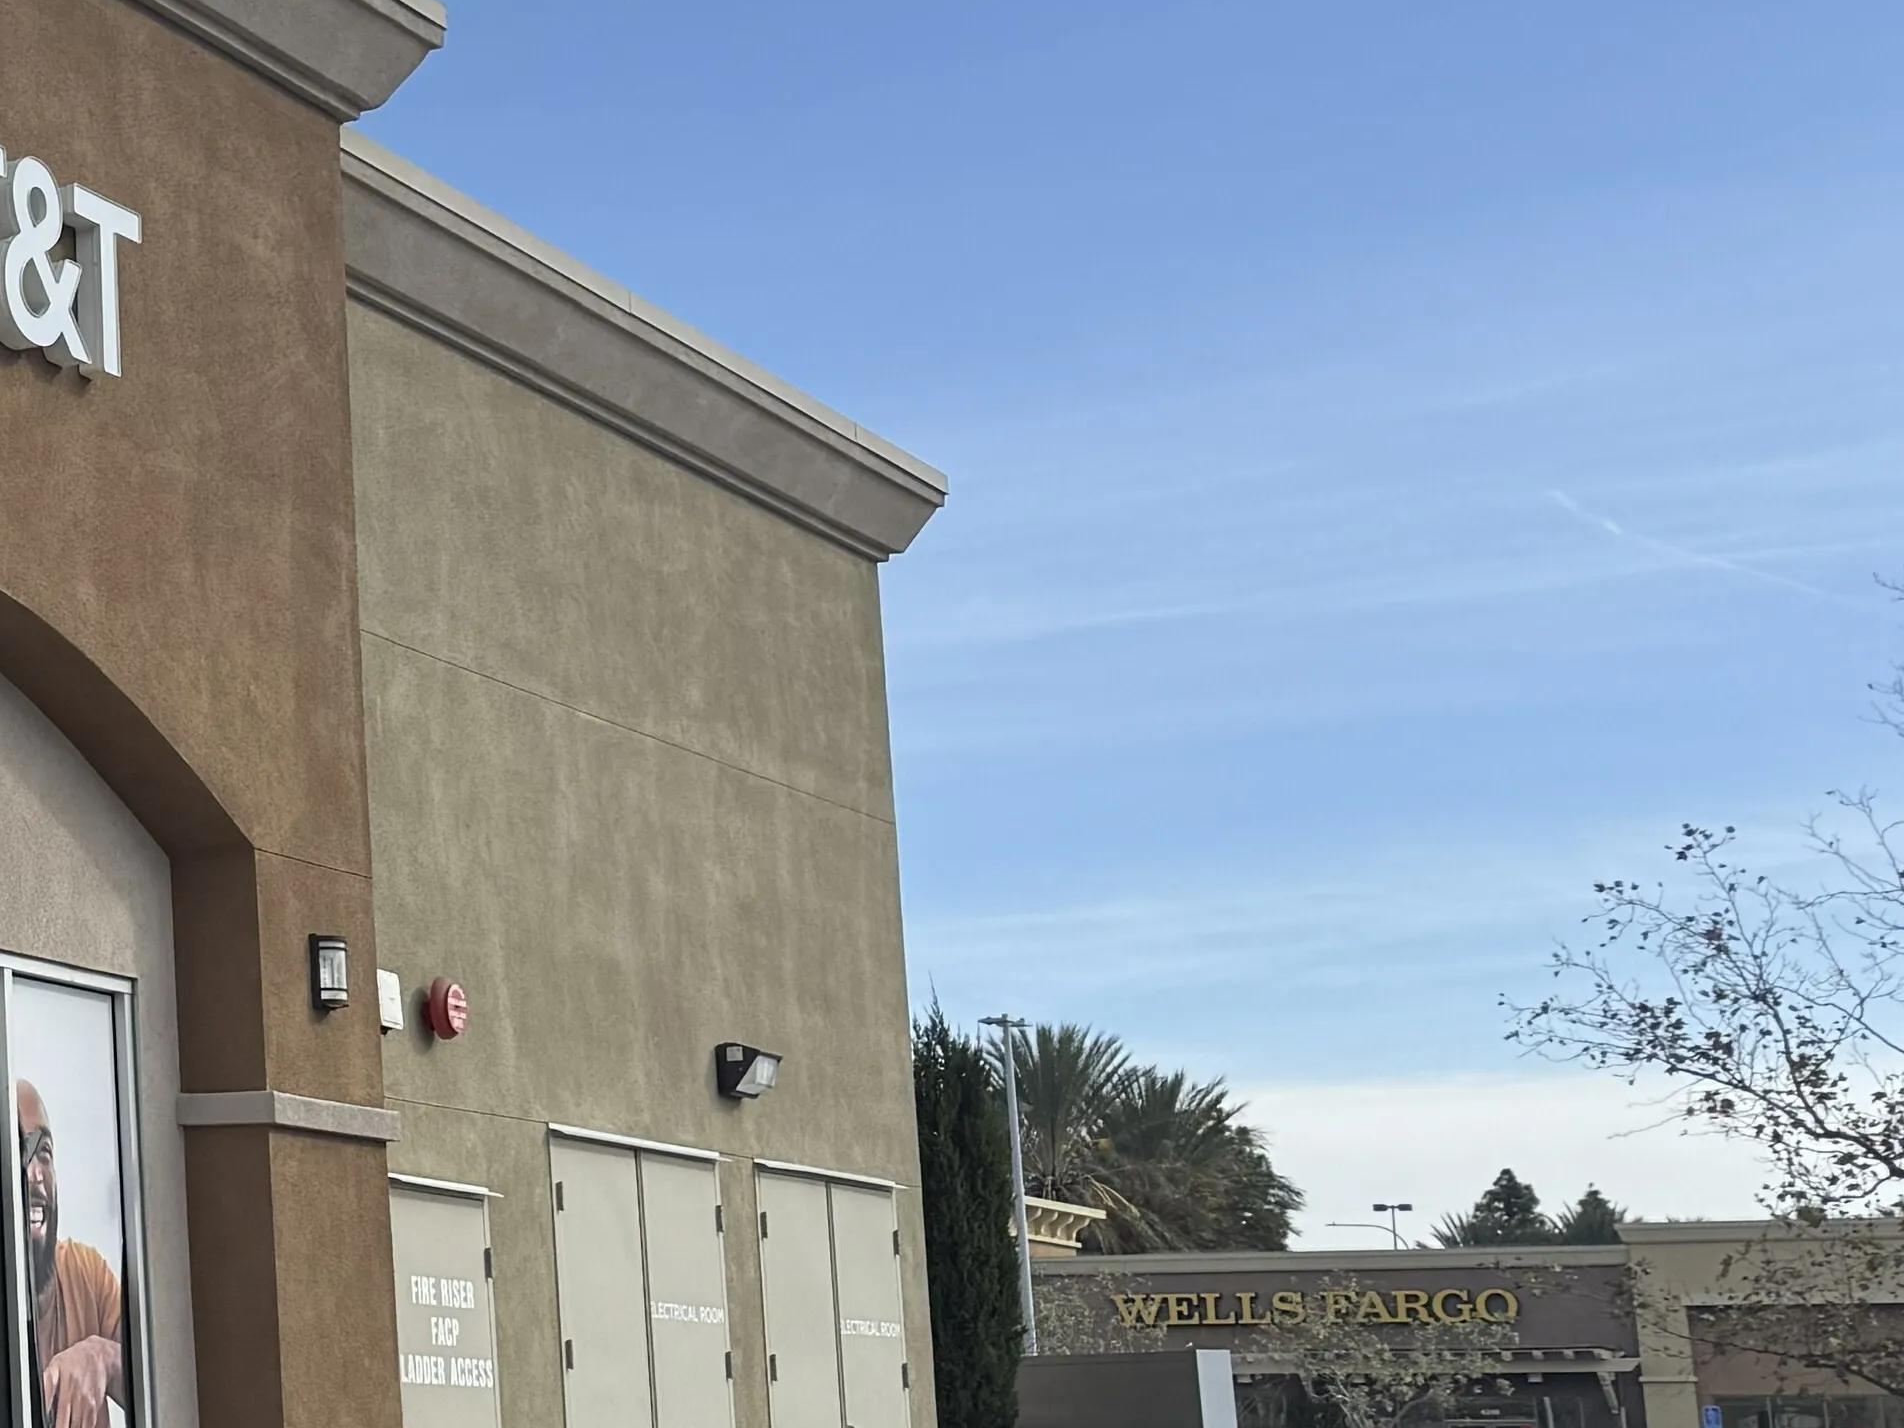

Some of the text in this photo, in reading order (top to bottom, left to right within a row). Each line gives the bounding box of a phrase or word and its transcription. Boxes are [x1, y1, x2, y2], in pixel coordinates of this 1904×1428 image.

[410, 1275, 475, 1309] FIRE RISER
[1110, 1288, 1520, 1326] WELLS FARGO
[430, 1316, 460, 1347] FACP
[700, 1306, 725, 1324] ROOM
[400, 1353, 494, 1389] LADDER ACCESS
